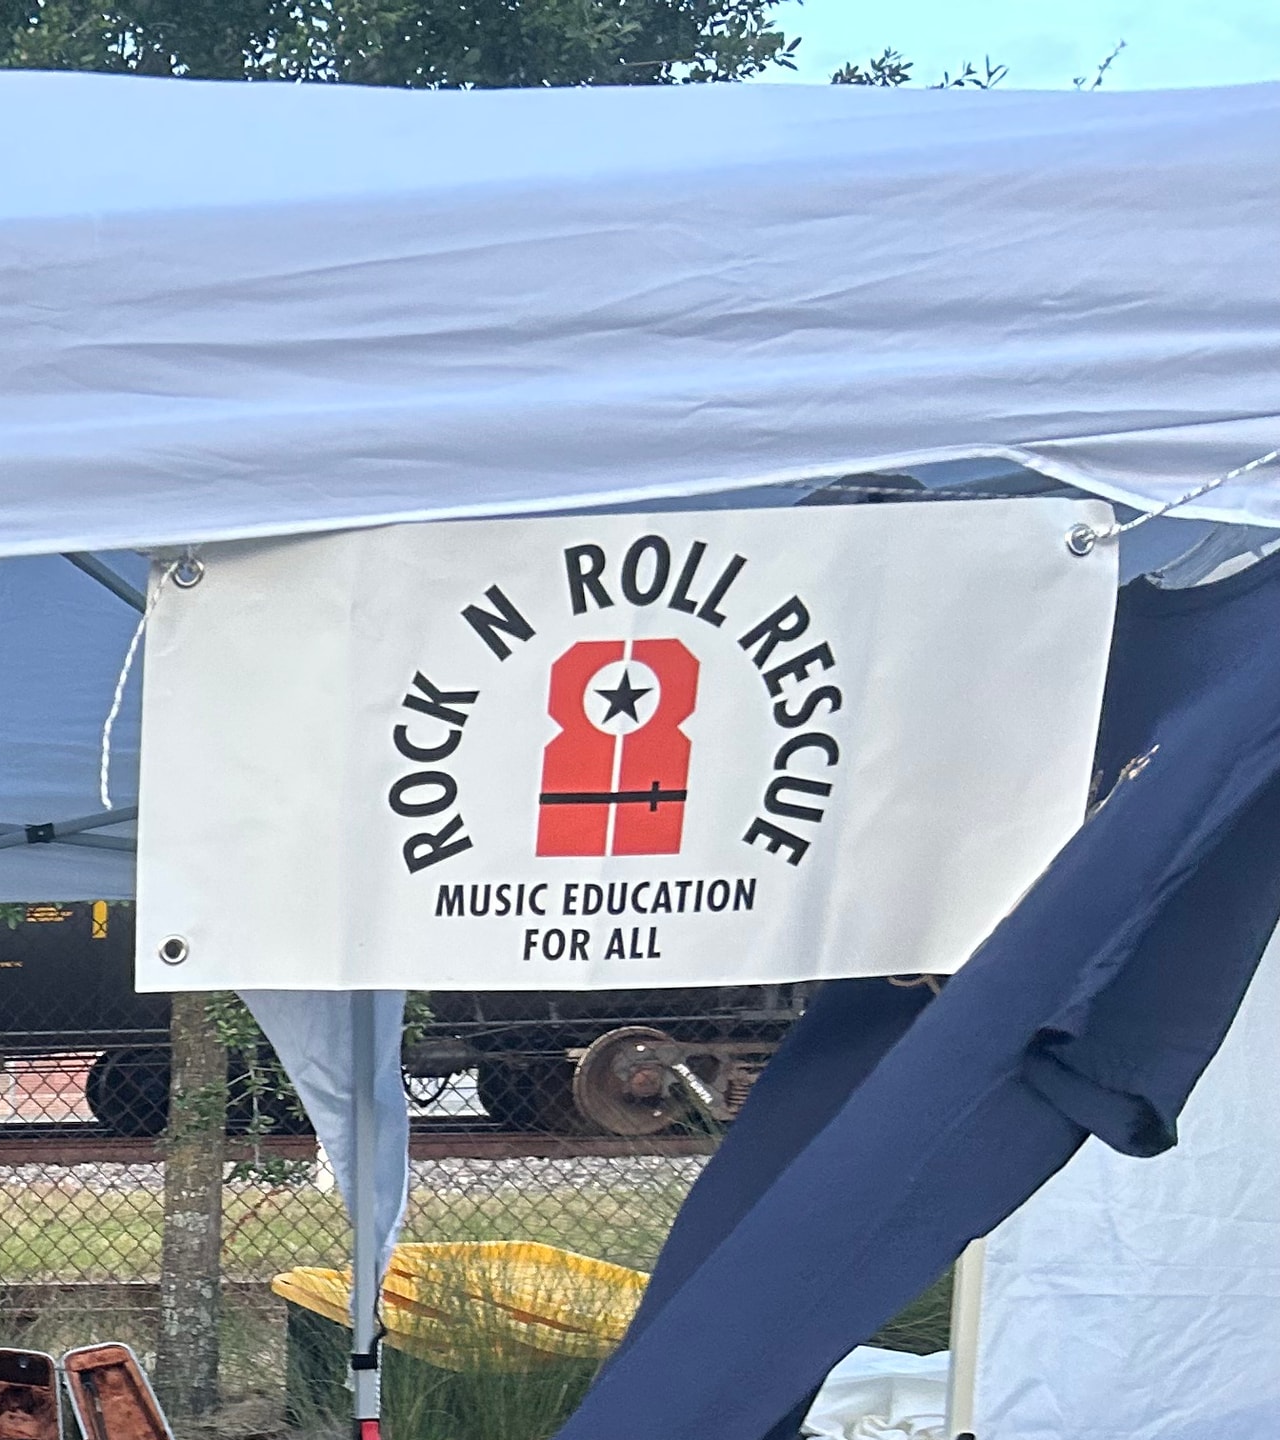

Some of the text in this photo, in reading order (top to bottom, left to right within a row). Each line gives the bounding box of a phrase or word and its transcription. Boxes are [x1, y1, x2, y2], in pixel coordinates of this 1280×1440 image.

[387, 534, 843, 875] ROCK N ROLL RESCUE
[434, 876, 757, 919] MUSIC EDUCATION
[524, 926, 662, 961] FOR ALL
